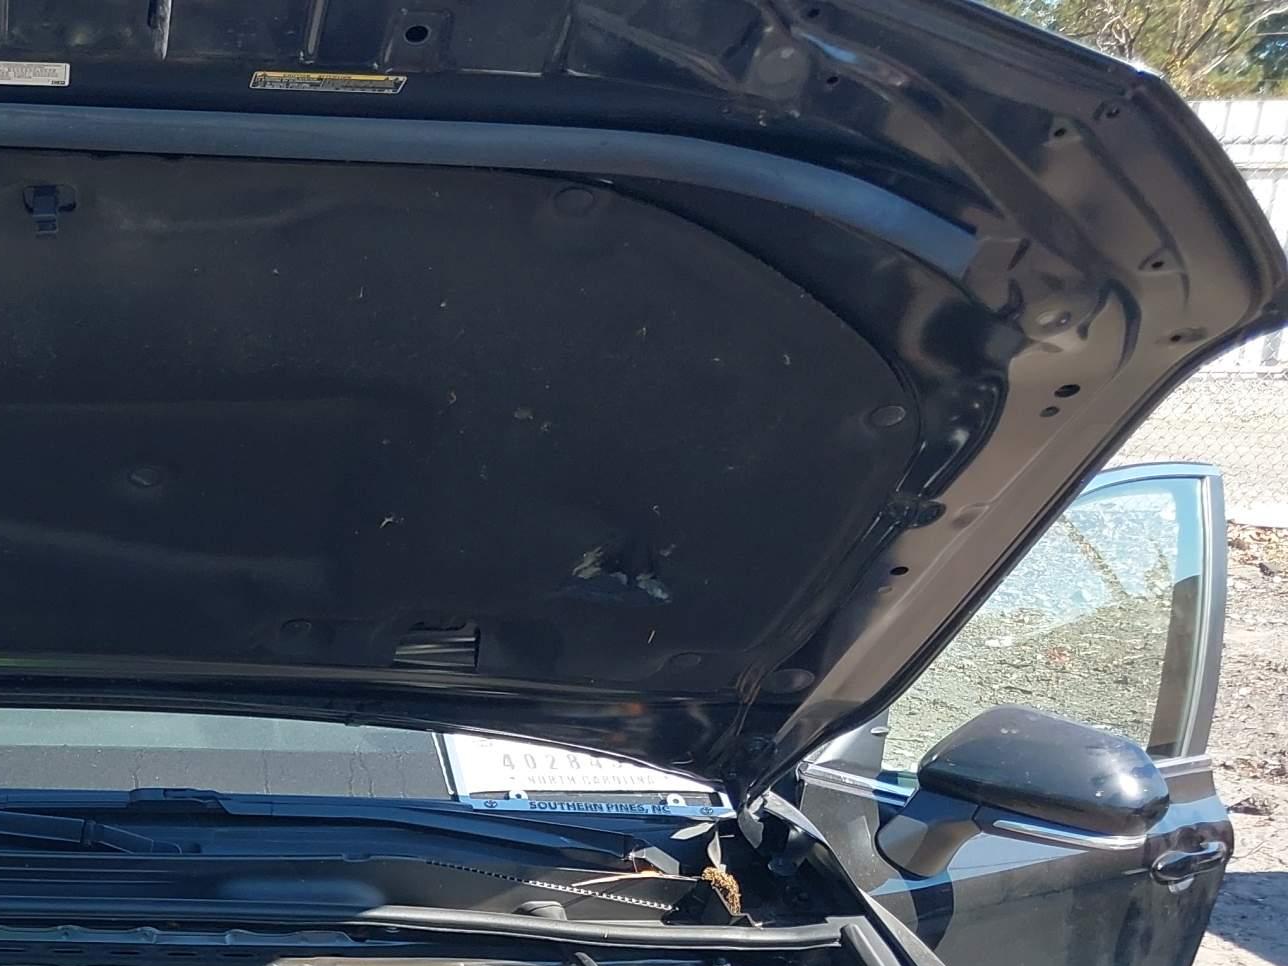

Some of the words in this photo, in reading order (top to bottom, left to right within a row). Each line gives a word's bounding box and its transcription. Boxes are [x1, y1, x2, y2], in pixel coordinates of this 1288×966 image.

[528, 800, 603, 812] SOUTHERN
[607, 803, 650, 814] PINES,
[652, 804, 672, 815] NC
